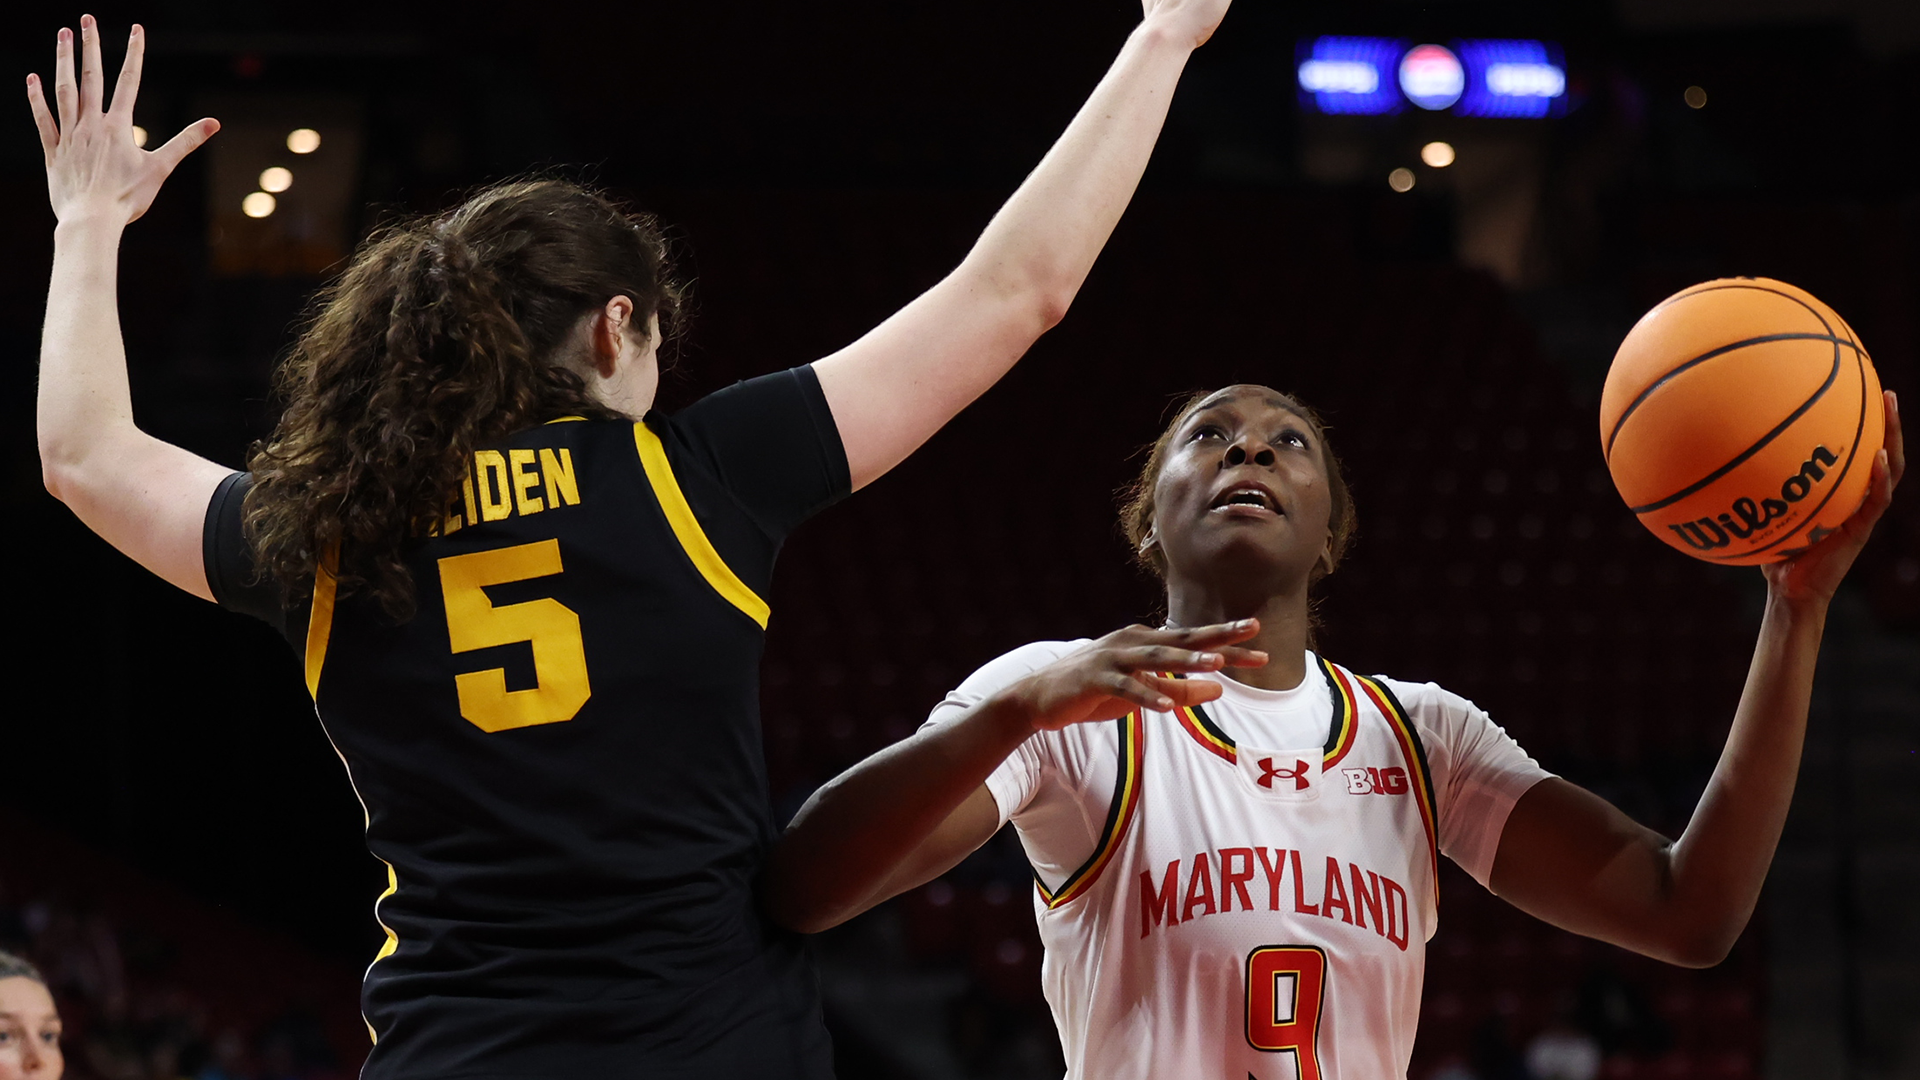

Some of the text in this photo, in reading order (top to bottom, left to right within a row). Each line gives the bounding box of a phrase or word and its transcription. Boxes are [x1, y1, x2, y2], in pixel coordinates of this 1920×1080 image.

[411, 448, 580, 537] EIDEN
[1668, 444, 1839, 550] Wilson
[437, 538, 591, 733] 5
[1140, 847, 1409, 951] MARYLAND
[1245, 945, 1327, 1080] 9
